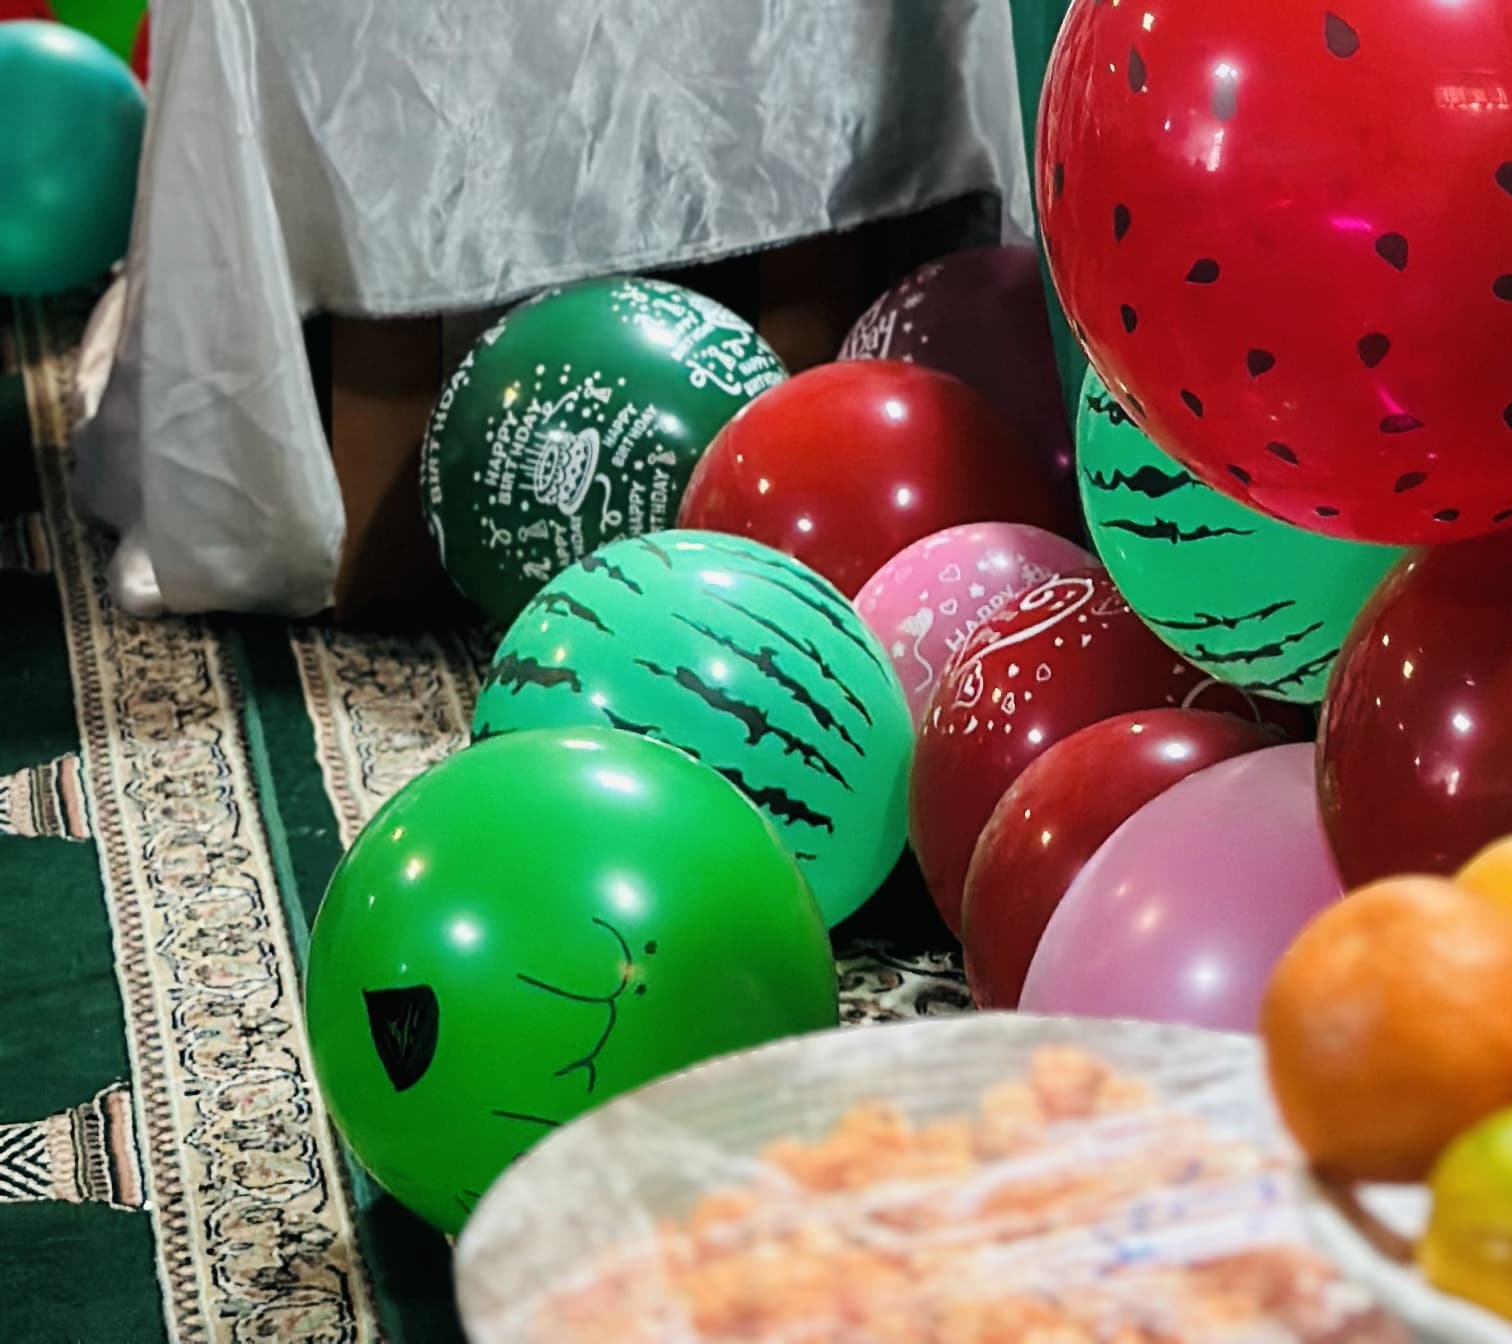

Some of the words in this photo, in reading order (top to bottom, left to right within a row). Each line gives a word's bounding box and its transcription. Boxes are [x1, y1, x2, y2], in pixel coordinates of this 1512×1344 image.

[484, 409, 519, 486] HAPPY
[498, 397, 542, 505] BIRTHDAY
[602, 401, 638, 449] HAPPY
[611, 403, 658, 469] BIRTHDAY
